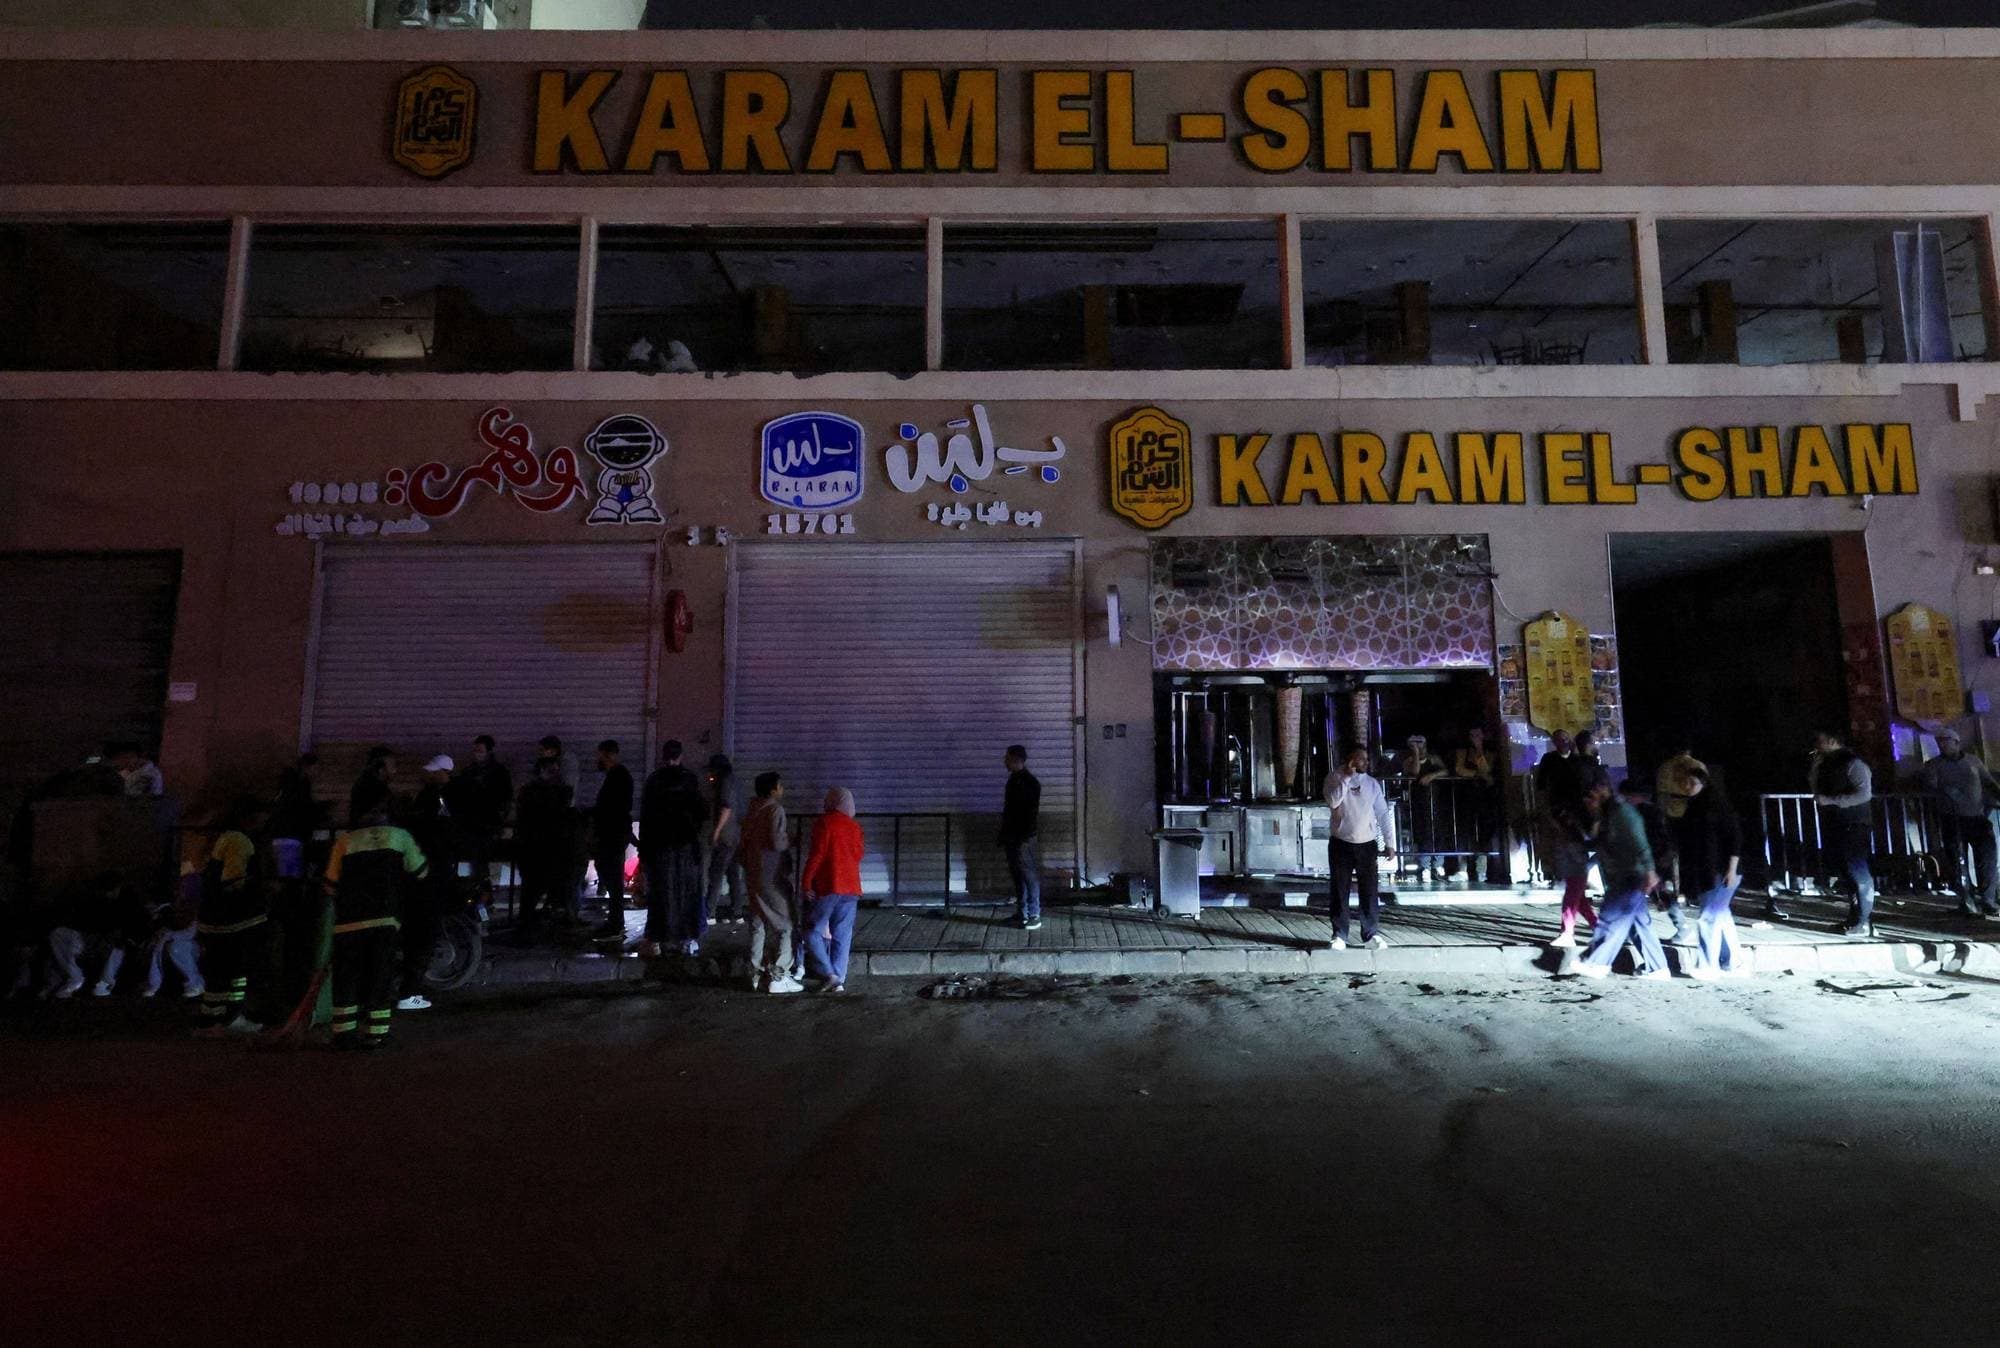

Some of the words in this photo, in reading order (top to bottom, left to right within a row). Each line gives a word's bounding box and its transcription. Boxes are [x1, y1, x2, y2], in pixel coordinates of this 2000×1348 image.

[532, 69, 998, 173] KARAM
[1031, 67, 1602, 174] EL-SHAM
[1217, 432, 1525, 505] KARAM
[1542, 423, 1919, 503] EL-SHAM
